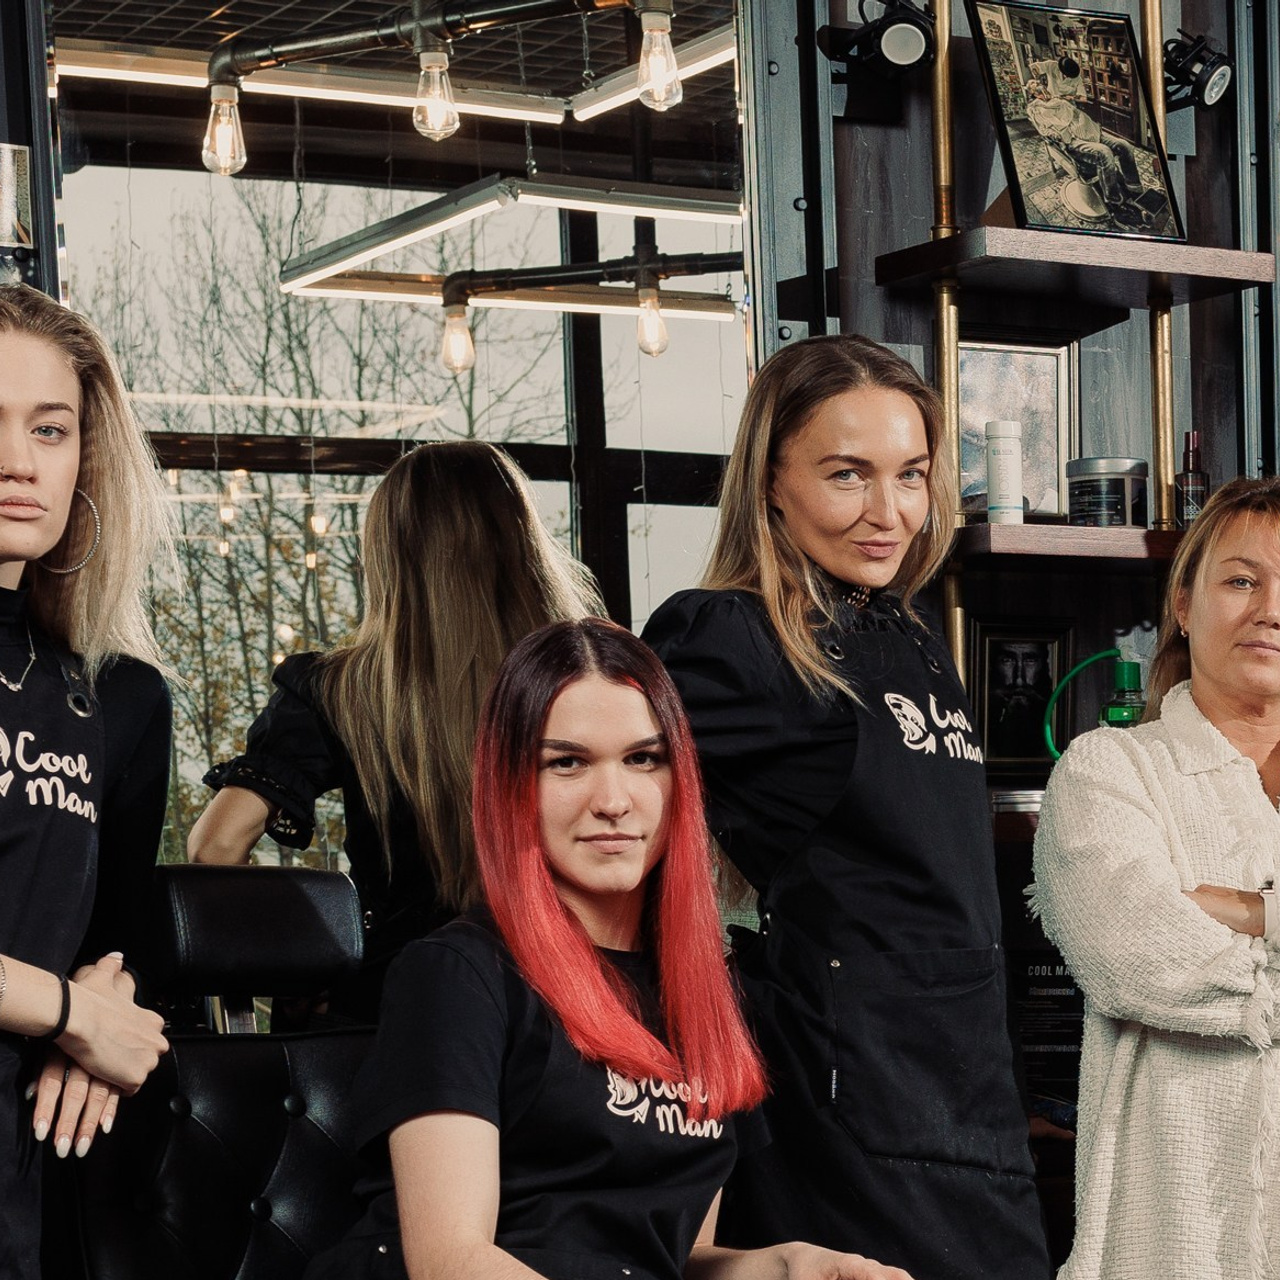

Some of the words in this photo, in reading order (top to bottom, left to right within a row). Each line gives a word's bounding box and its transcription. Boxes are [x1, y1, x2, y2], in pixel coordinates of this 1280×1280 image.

[15, 731, 92, 784] Cool
[943, 731, 984, 764] Man
[25, 776, 98, 823] Man
[1028, 965, 1053, 976] COOL
[1055, 965, 1071, 976] MA
[655, 1103, 723, 1139] Man
